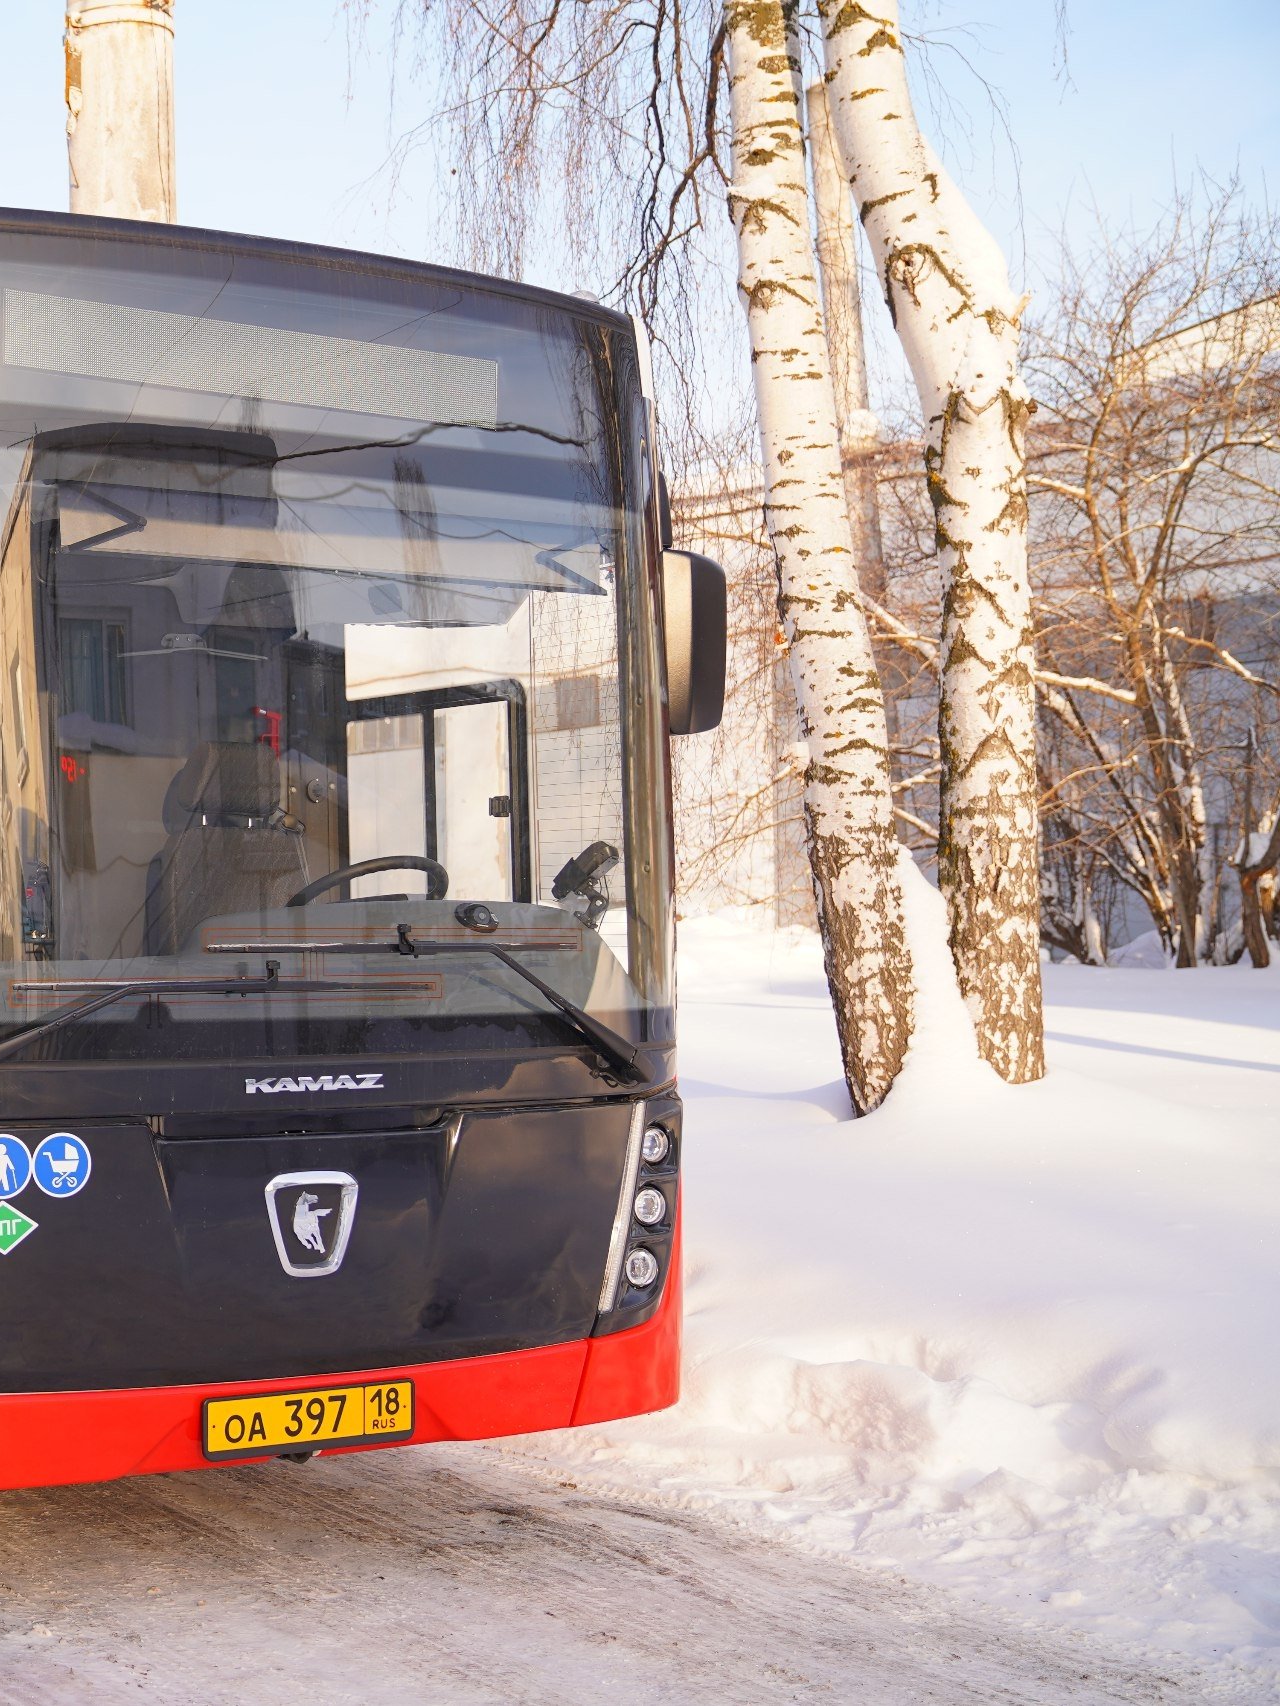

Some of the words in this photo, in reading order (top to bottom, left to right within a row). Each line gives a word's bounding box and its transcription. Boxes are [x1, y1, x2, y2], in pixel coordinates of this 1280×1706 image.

[245, 1073, 384, 1094] KAMAZ
[284, 1394, 347, 1438] 397
[369, 1387, 400, 1417] 18
[372, 1417, 396, 1430] RUS
